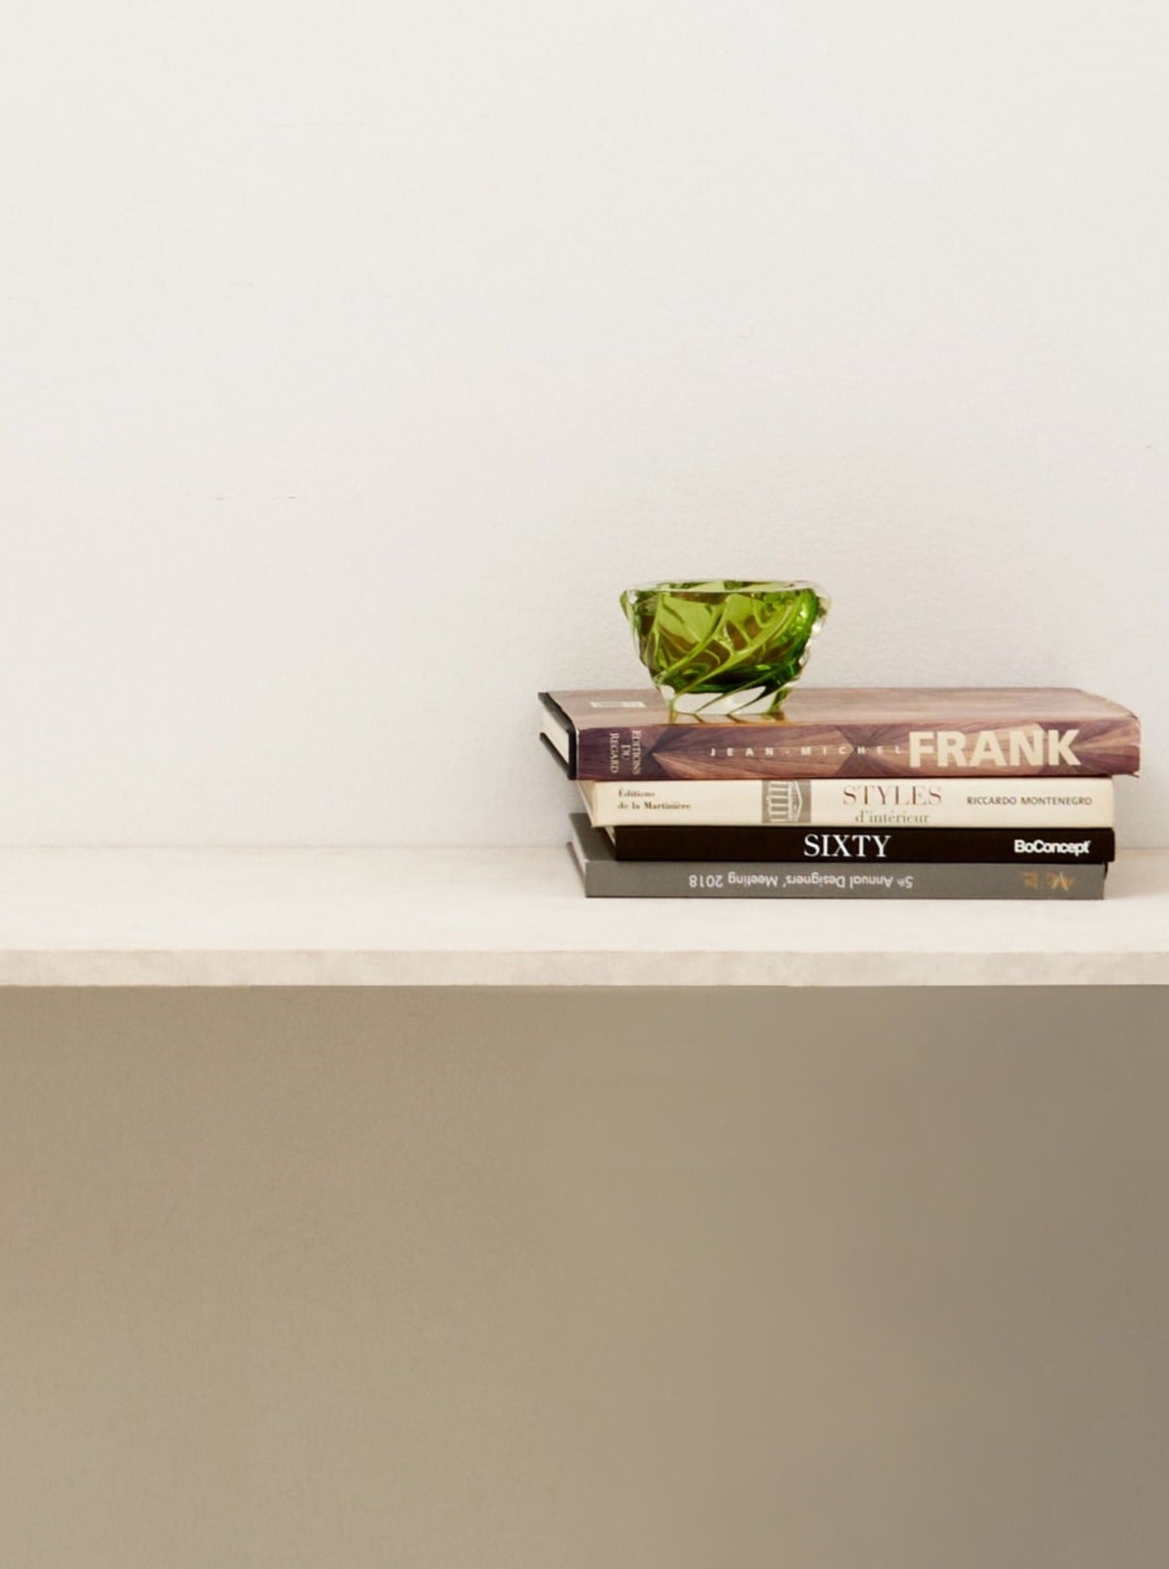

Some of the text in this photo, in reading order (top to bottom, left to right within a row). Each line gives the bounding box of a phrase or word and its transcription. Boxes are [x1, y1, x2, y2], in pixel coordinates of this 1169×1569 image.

[609, 732, 619, 774] REGARD
[908, 729, 1082, 768] FRANK
[842, 785, 942, 806] STYLES
[966, 796, 1093, 806] RICCARDO MONTENEGRO
[617, 801, 629, 810] de
[631, 801, 641, 810] la
[803, 833, 892, 858] SIXTY
[1014, 839, 1091, 857] BoConcept
[689, 873, 723, 888] 2018
[727, 871, 778, 888] Meeting
[849, 874, 893, 889] Annual
